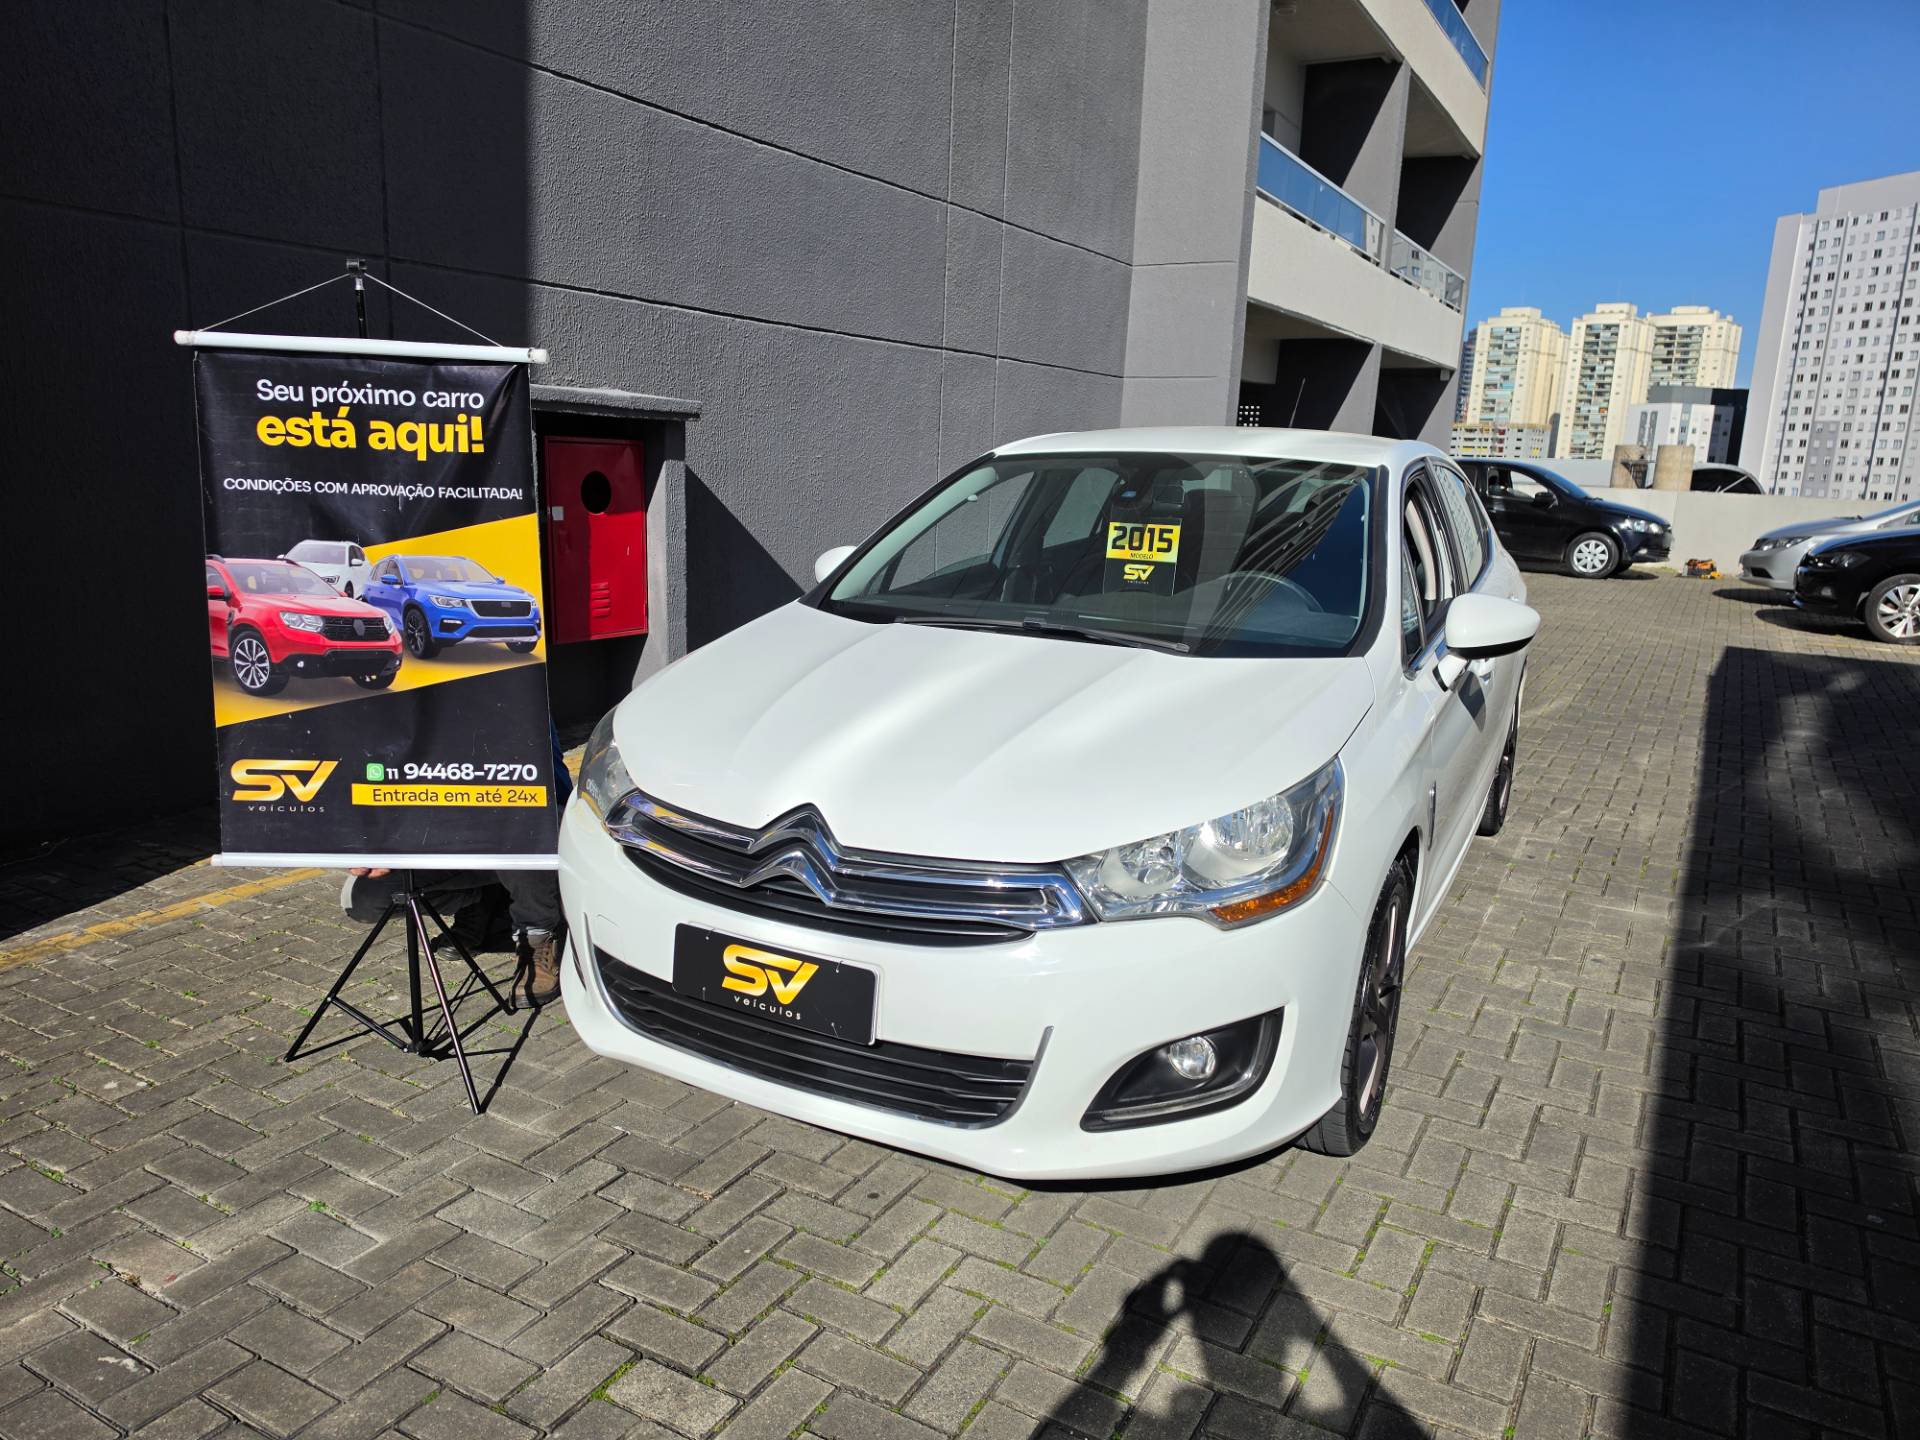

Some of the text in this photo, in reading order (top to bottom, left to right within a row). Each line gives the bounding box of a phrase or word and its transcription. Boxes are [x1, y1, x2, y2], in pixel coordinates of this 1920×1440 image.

[257, 379, 484, 409] Seu próximo carro
[256, 407, 485, 461] está aqui!
[223, 477, 523, 500] CONDIÇÕES COM APROVAÇÃO FACILITADA!
[1111, 525, 1173, 553] 2015
[1123, 563, 1155, 581] SV
[230, 758, 340, 803] SV
[403, 762, 539, 782] 94468-7270
[372, 787, 538, 804] Entrada em até 24x
[721, 943, 820, 1005] SV
